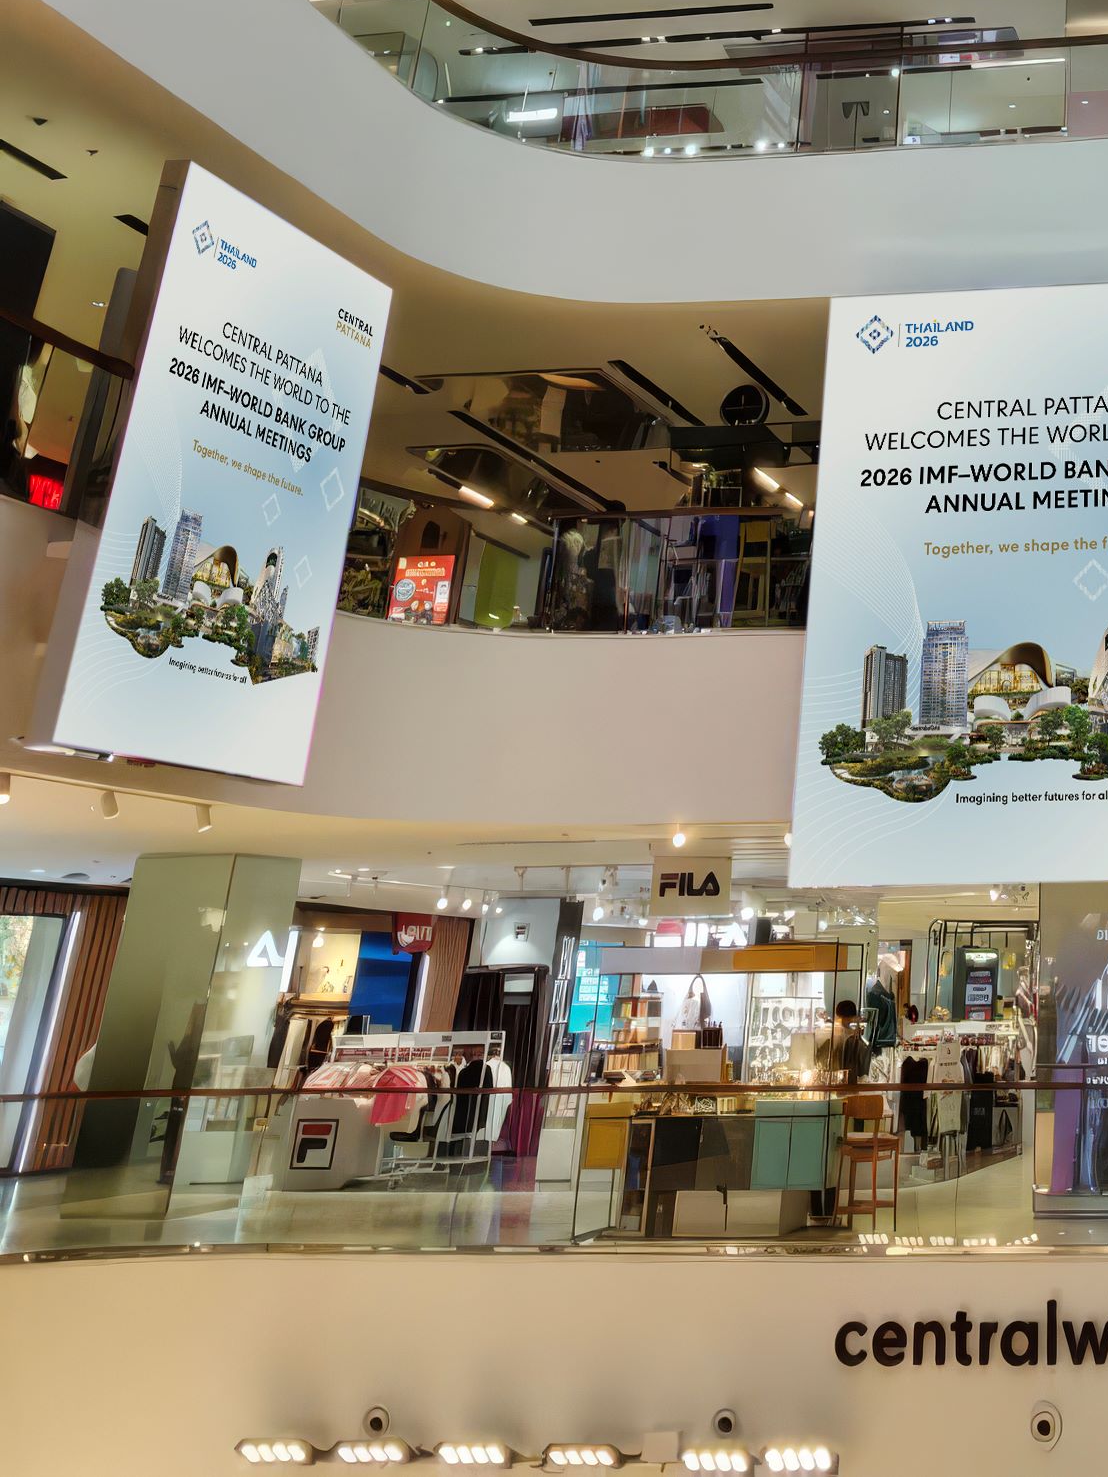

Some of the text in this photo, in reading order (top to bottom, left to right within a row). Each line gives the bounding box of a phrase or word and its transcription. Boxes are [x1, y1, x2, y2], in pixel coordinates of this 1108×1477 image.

[220, 238, 256, 268] THAILAND
[335, 320, 370, 349] PATTANA
[337, 308, 373, 336] CENTRAL
[905, 318, 973, 333] THAILAND
[222, 321, 322, 387] CENTRAL PATTANA
[905, 335, 938, 347] 2026
[179, 325, 351, 425] WELCOMES THE WORLD TO THE
[168, 357, 200, 384] 2026
[274, 406, 307, 435] BANK
[307, 423, 345, 452] GROUP
[937, 398, 1036, 420] CENTRAL
[199, 400, 312, 462] ANNUAL MEETINGS
[864, 427, 990, 450] WELCOMES
[997, 426, 1039, 445] THE
[193, 439, 303, 495] Together, we shape the future.
[860, 467, 912, 486] 2026
[924, 491, 1025, 513] ANNUAL
[924, 541, 992, 558] Together,
[998, 542, 1018, 552] we
[1023, 538, 1069, 554] shape
[1073, 537, 1097, 550] the
[955, 793, 1007, 805] Imagining
[1011, 791, 1042, 802] better
[1044, 791, 1077, 801] futures
[1081, 790, 1095, 800] for
[659, 871, 720, 897] FILA
